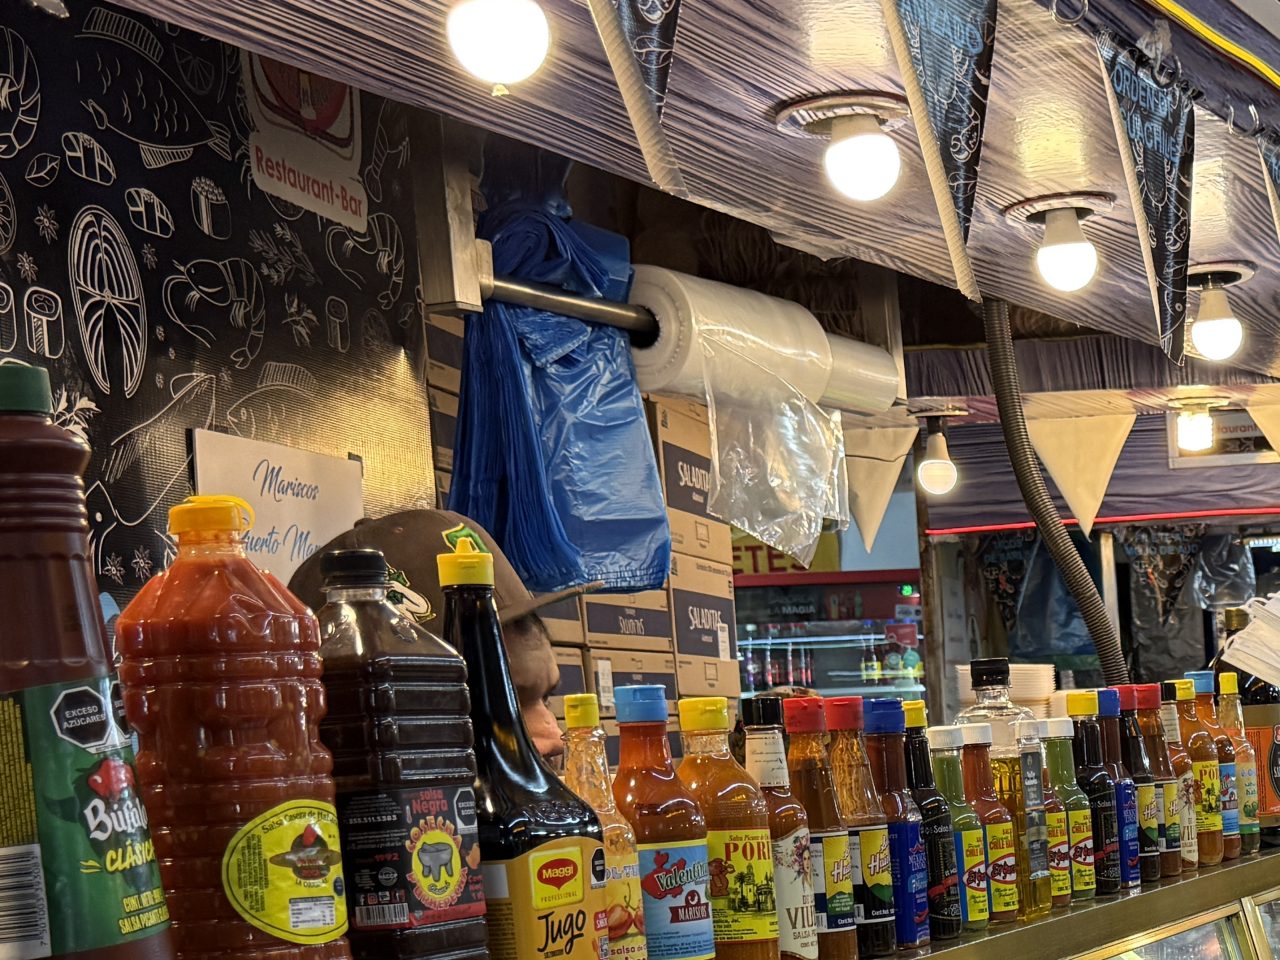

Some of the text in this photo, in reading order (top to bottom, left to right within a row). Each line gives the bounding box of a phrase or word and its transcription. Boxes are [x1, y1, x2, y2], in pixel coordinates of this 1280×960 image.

[1113, 64, 1156, 112] ORDEN
[255, 145, 363, 218] Restaurant-Bar
[253, 459, 319, 502] Mariscos
[677, 461, 711, 493] SALADITA
[241, 518, 281, 556] uerto
[781, 605, 817, 615] MAGIA
[62, 714, 106, 730] AZÚCARES
[65, 706, 98, 718] EXCESO
[542, 863, 574, 880] Maggi
[656, 861, 709, 892] Valentin
[541, 891, 577, 903] PROFESSIONAL
[119, 914, 140, 936] SALSA
[678, 906, 707, 922] MARISCOS
[537, 910, 586, 955] Jugo
[610, 945, 636, 956] salsa
